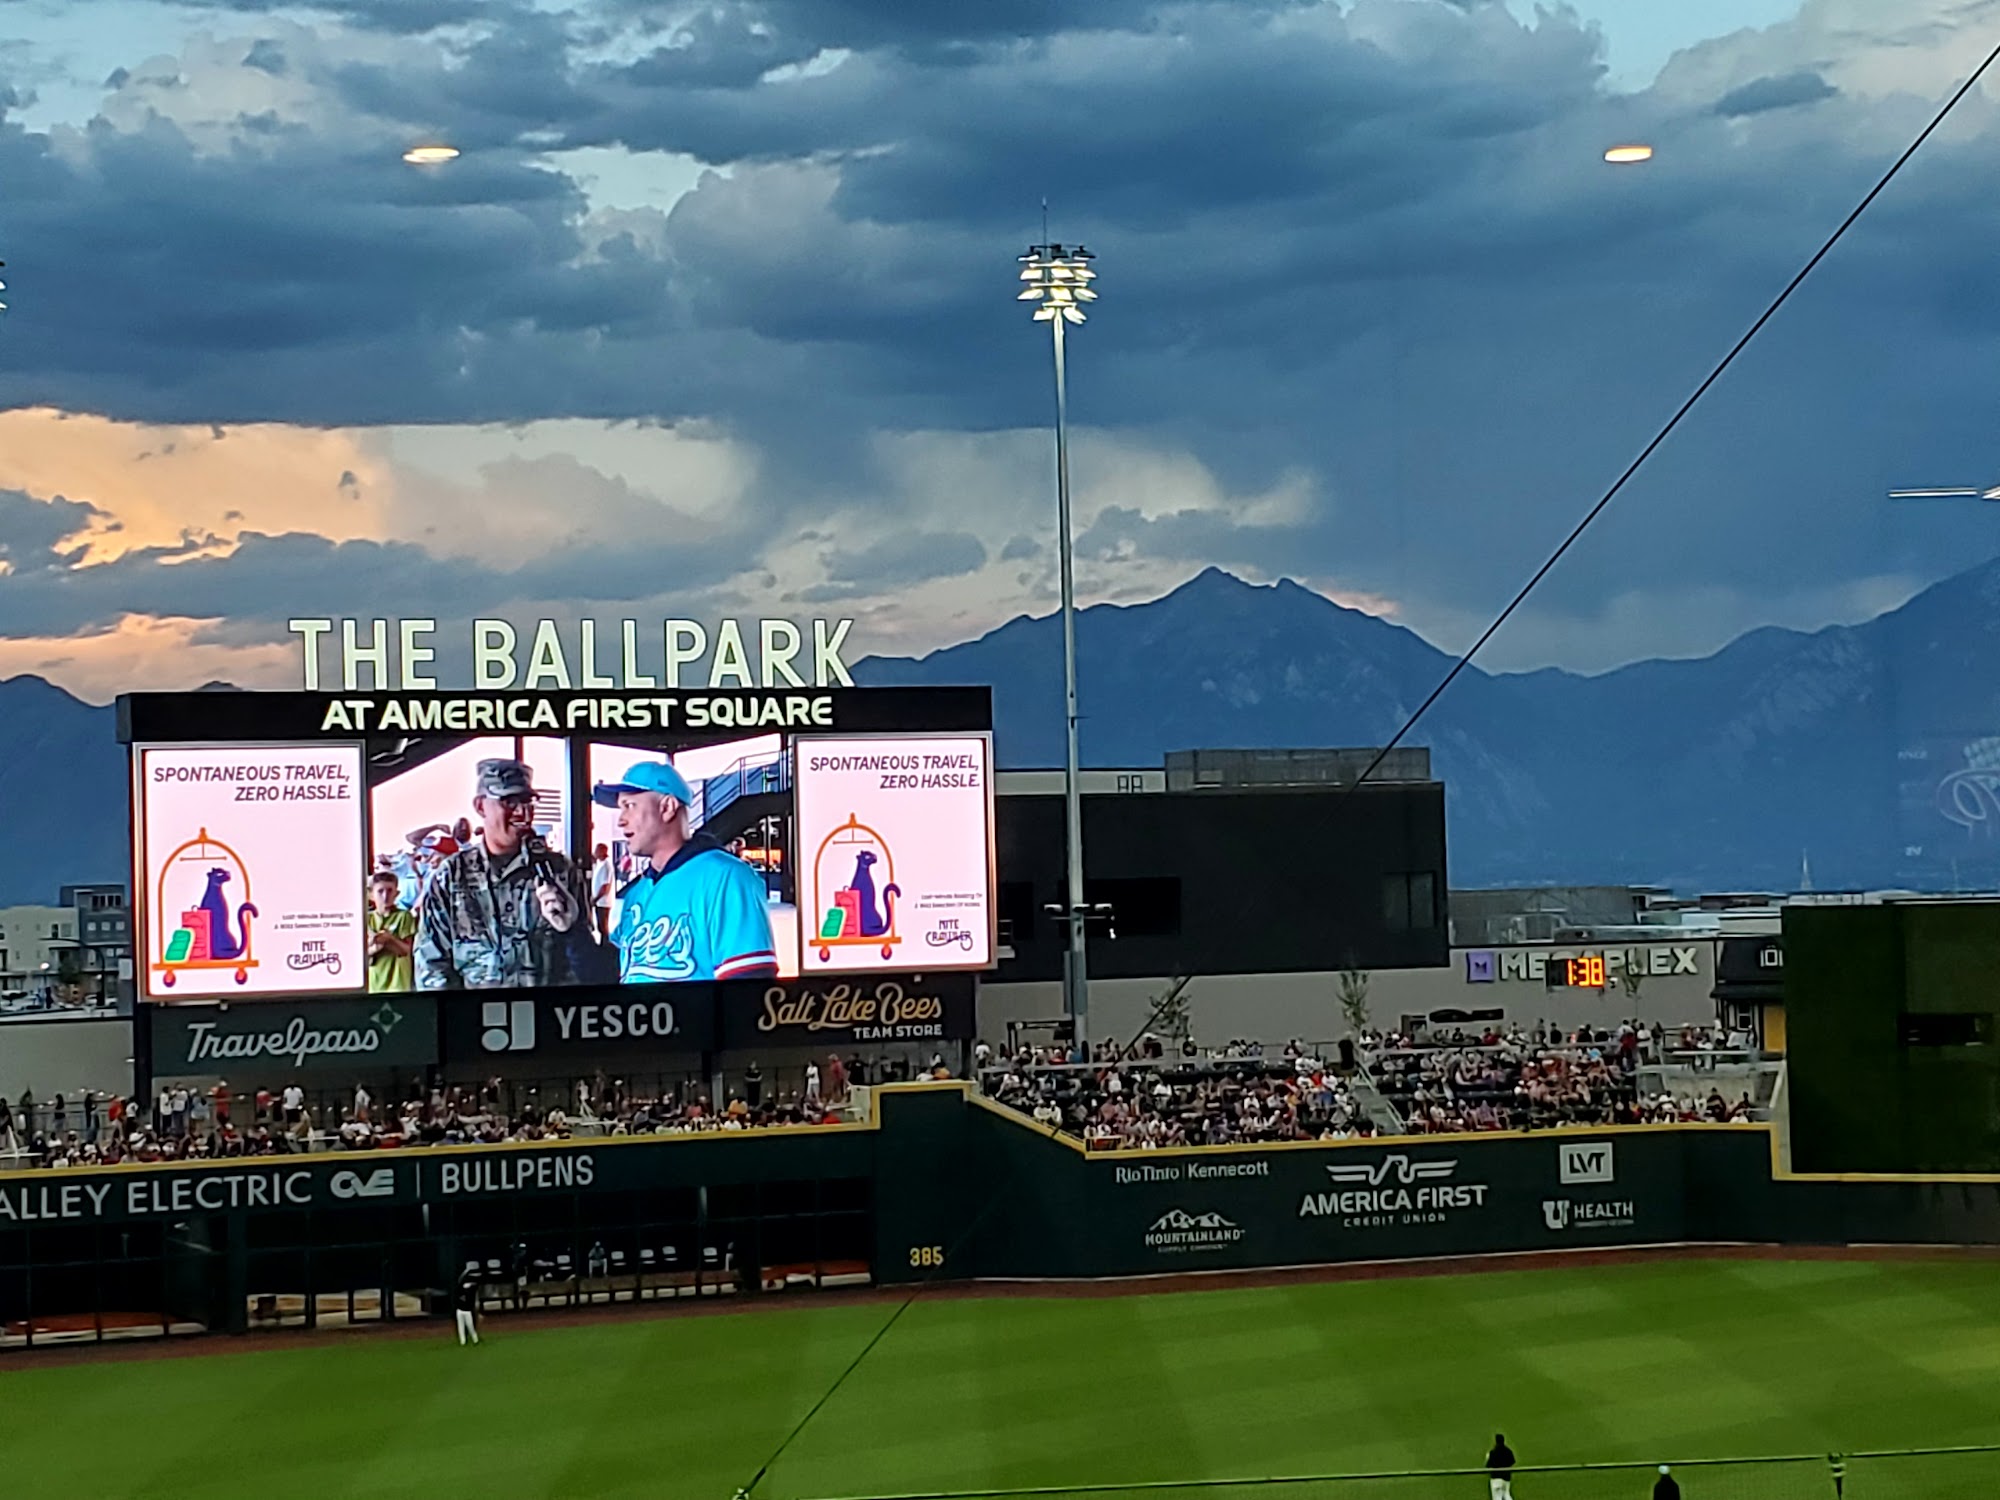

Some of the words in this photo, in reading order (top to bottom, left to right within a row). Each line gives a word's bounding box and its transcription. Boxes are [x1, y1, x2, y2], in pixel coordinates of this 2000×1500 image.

[289, 618, 437, 691] THE
[474, 618, 856, 690] BALLPARK
[321, 700, 375, 730] AT
[378, 698, 560, 730] AMERICA
[566, 698, 679, 728] FIRST
[685, 695, 834, 728] SQUARE
[808, 756, 920, 771] SPONTANEOUS
[922, 754, 980, 771] TRAVEL,
[153, 765, 281, 782] SPONTANEOUS
[284, 764, 351, 782] TRAVEL,
[879, 775, 919, 789] ZERO
[921, 773, 981, 789] HASSLE.
[234, 786, 280, 801] ZERO
[283, 784, 351, 801] HASSLE.
[302, 940, 326, 952] NITE
[1567, 957, 1604, 987] 1:38
[758, 987, 816, 1031] Salt
[807, 984, 877, 1031] Lake
[875, 982, 942, 1025] Bees
[554, 1002, 674, 1039] YESCO
[853, 1027, 893, 1039] TEAM
[895, 1024, 943, 1037] STORE
[187, 1017, 379, 1067] Travelpass
[1188, 1161, 1270, 1179] Kennecott
[1569, 1152, 1606, 1174] LVT
[128, 1172, 312, 1213] ELECTRIC
[441, 1155, 594, 1194] BULLPENS
[1300, 1188, 1412, 1217] AMERICA
[1417, 1185, 1489, 1209] FIRST
[1574, 1201, 1634, 1219] HEALTH
[1344, 1215, 1395, 1227] CREDIT
[1402, 1212, 1446, 1224] UNION
[1145, 1229, 1241, 1246] MOUNTAINLAND
[910, 1246, 944, 1267] 385
